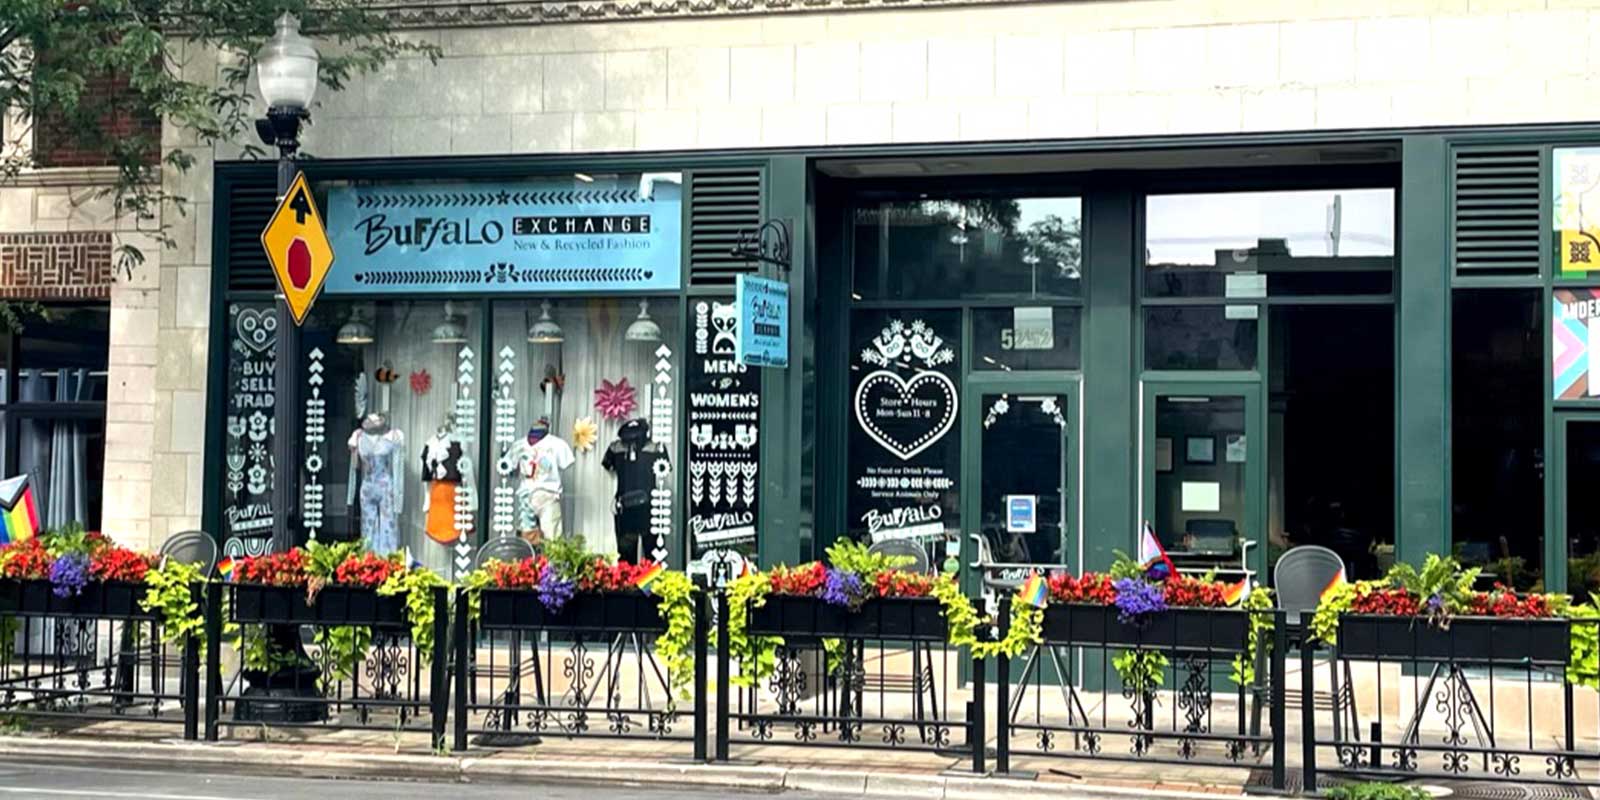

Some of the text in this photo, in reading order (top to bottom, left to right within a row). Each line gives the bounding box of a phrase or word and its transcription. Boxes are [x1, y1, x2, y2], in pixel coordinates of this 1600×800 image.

[514, 216, 649, 234] EXCHANGE
[513, 238, 650, 251] New & Recycled Fashion
[243, 361, 276, 375] BUY
[241, 378, 276, 391] SELL
[235, 394, 275, 408] TRAD
[690, 392, 759, 407] WOMEN'S
[881, 397, 937, 407] Store Hours
